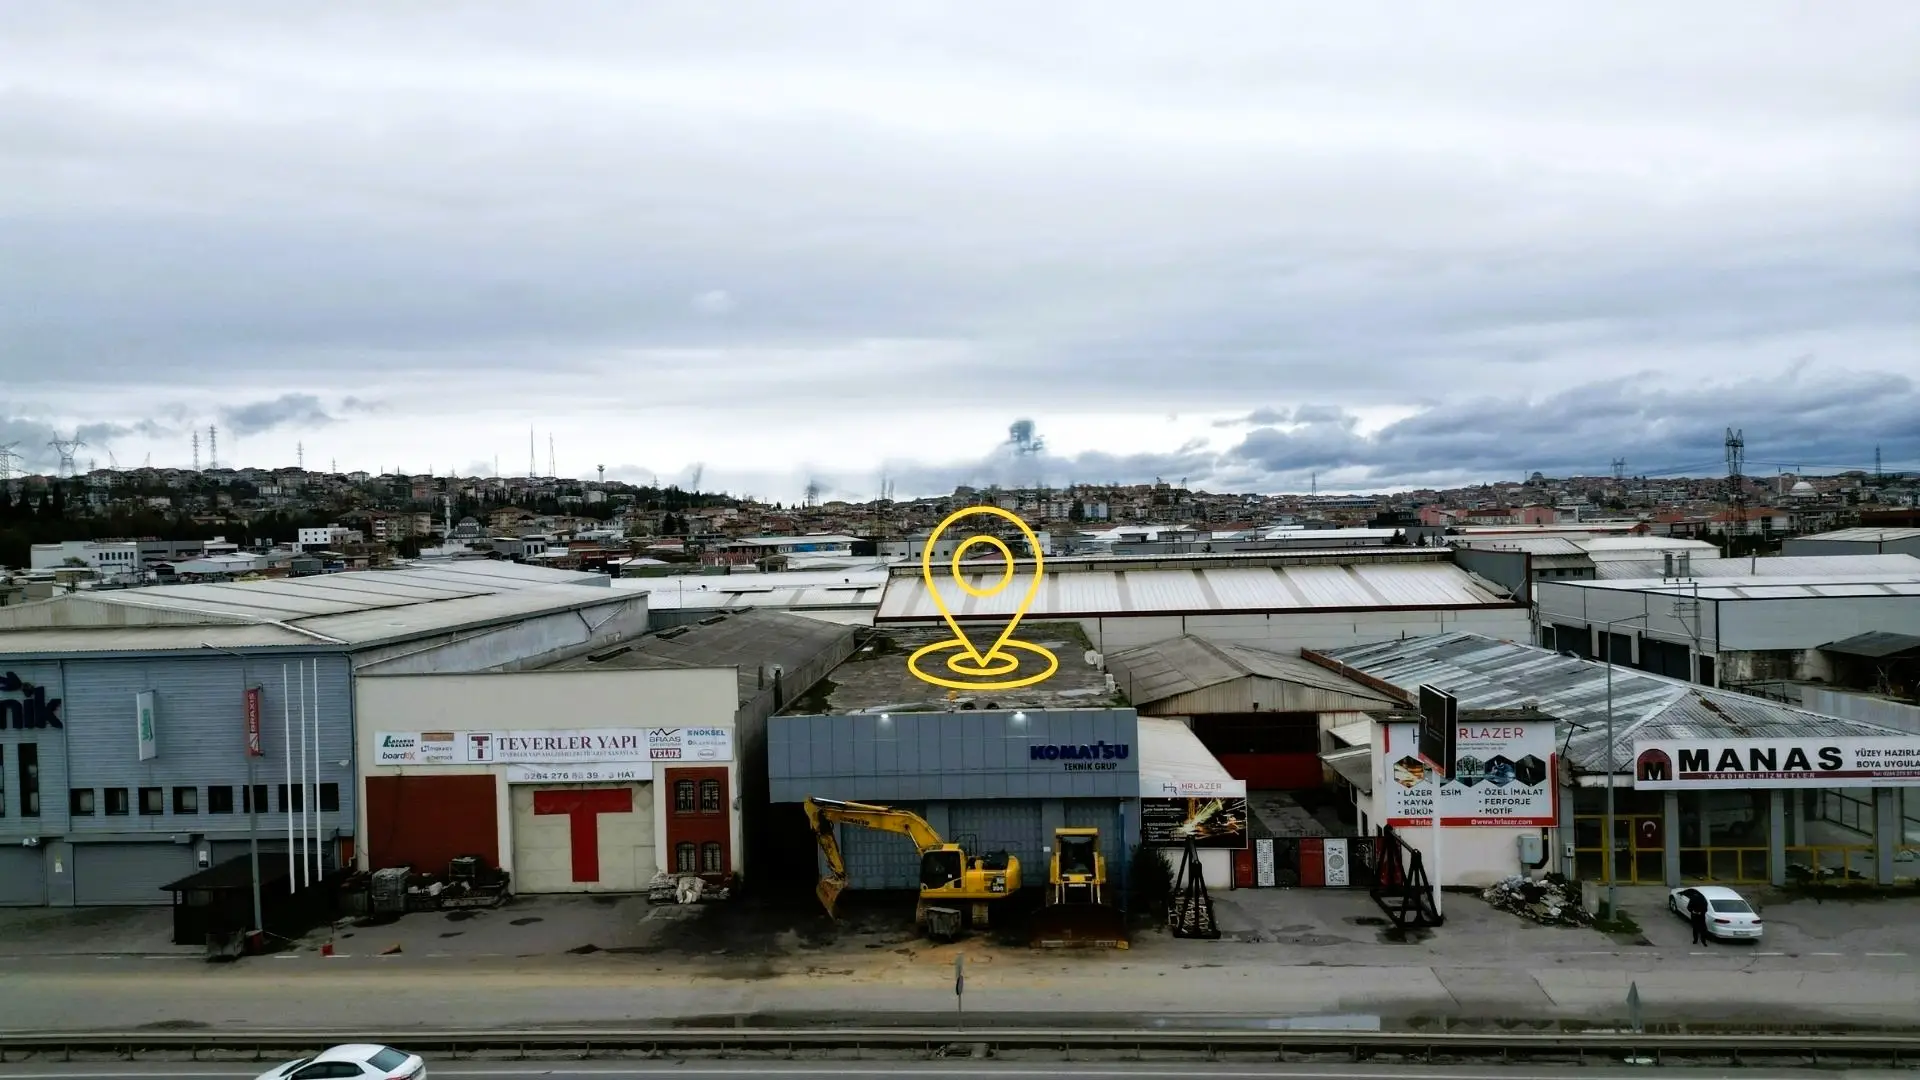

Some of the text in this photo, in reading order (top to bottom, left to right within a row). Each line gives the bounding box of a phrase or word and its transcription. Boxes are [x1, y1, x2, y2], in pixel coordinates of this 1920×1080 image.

[249, 692, 257, 732] BRAXIS
[1459, 727, 1524, 738] RLAZER
[496, 735, 638, 750] TEVERLER YAPI
[471, 736, 489, 759] T
[1030, 740, 1129, 760] KOMATSU
[651, 749, 681, 758] VELUX
[1855, 748, 1882, 757] YÜZEY
[1678, 746, 1843, 771] MANAS
[1064, 761, 1117, 771] TEKNİK GRUP
[1856, 760, 1882, 768] BOYA
[586, 771, 599, 779] 39
[617, 770, 636, 778] HAT
[1181, 782, 1222, 790] HRLAZER
[1403, 788, 1462, 797] LAZER ESİM
[1484, 788, 1544, 796] ÖZEL İMALAT
[1485, 807, 1513, 815] MOTİF
